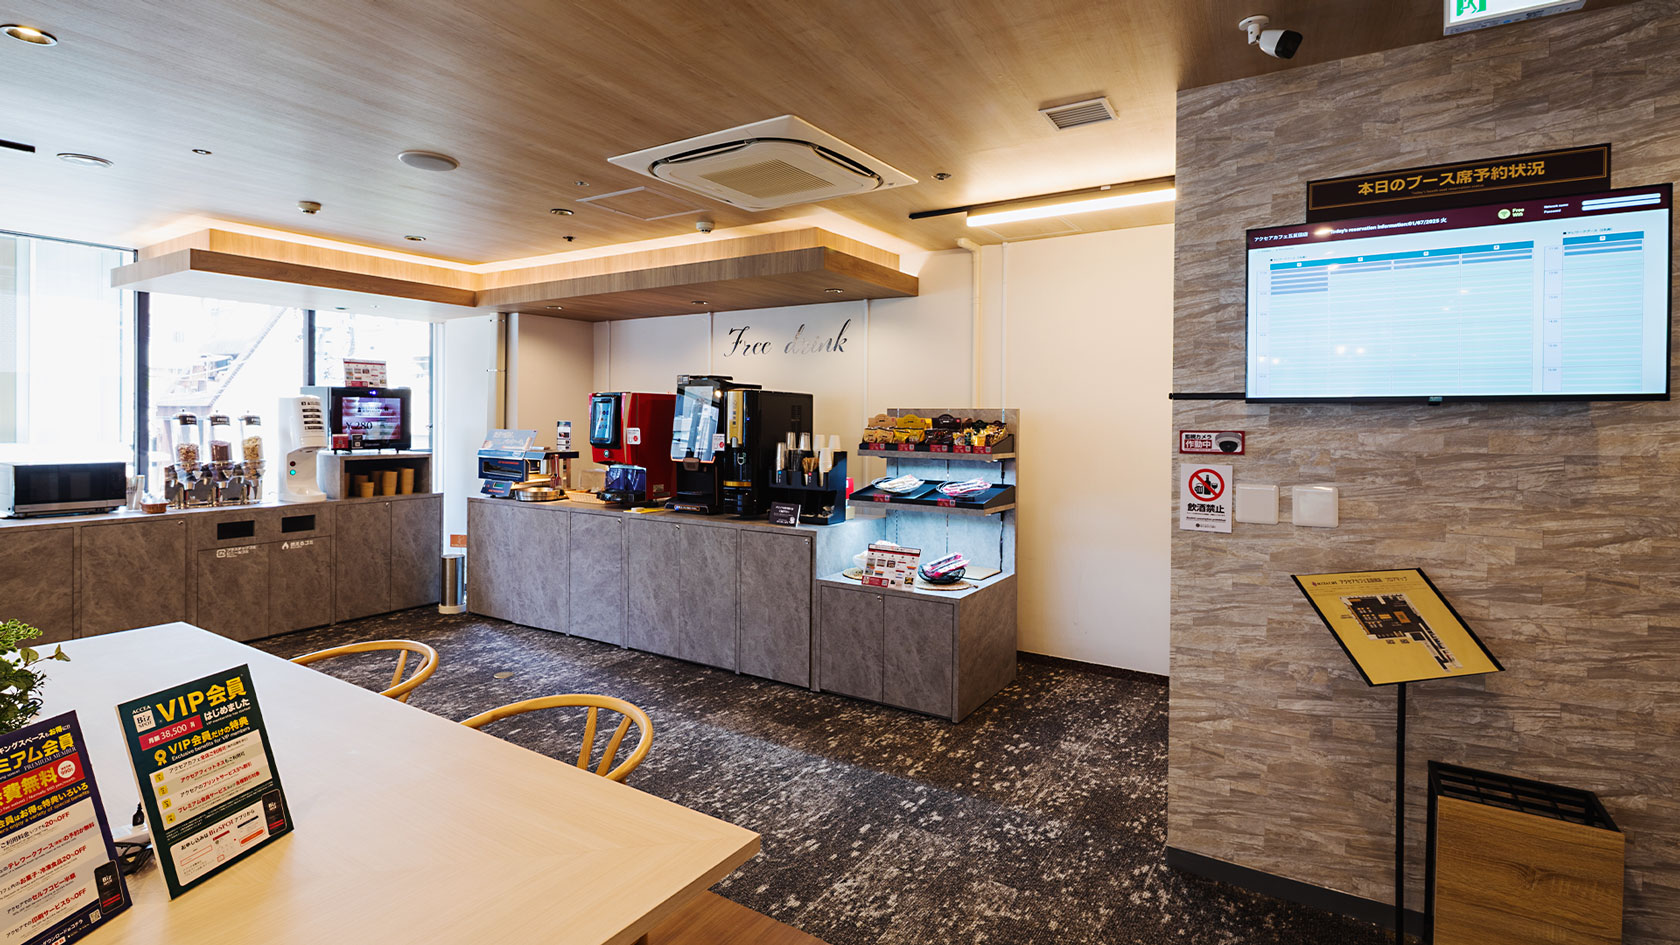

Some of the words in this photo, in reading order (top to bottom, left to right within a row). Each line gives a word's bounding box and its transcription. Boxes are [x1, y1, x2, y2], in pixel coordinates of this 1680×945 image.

[1357, 161, 1545, 196] 本日のブース席予約状況
[724, 325, 773, 358] Free
[784, 319, 852, 356] drink
[1187, 502, 1225, 514] 飲酒禁止
[154, 675, 247, 725] VIP会員
[203, 696, 250, 721] はじめました
[136, 713, 151, 724] Biz
[160, 723, 187, 739] 38,500
[167, 715, 249, 756] VIP会員だけの特典
[23, 755, 52, 771] PREMIUM
[52, 745, 76, 759] MEMBER
[171, 748, 194, 761] Exclusive
